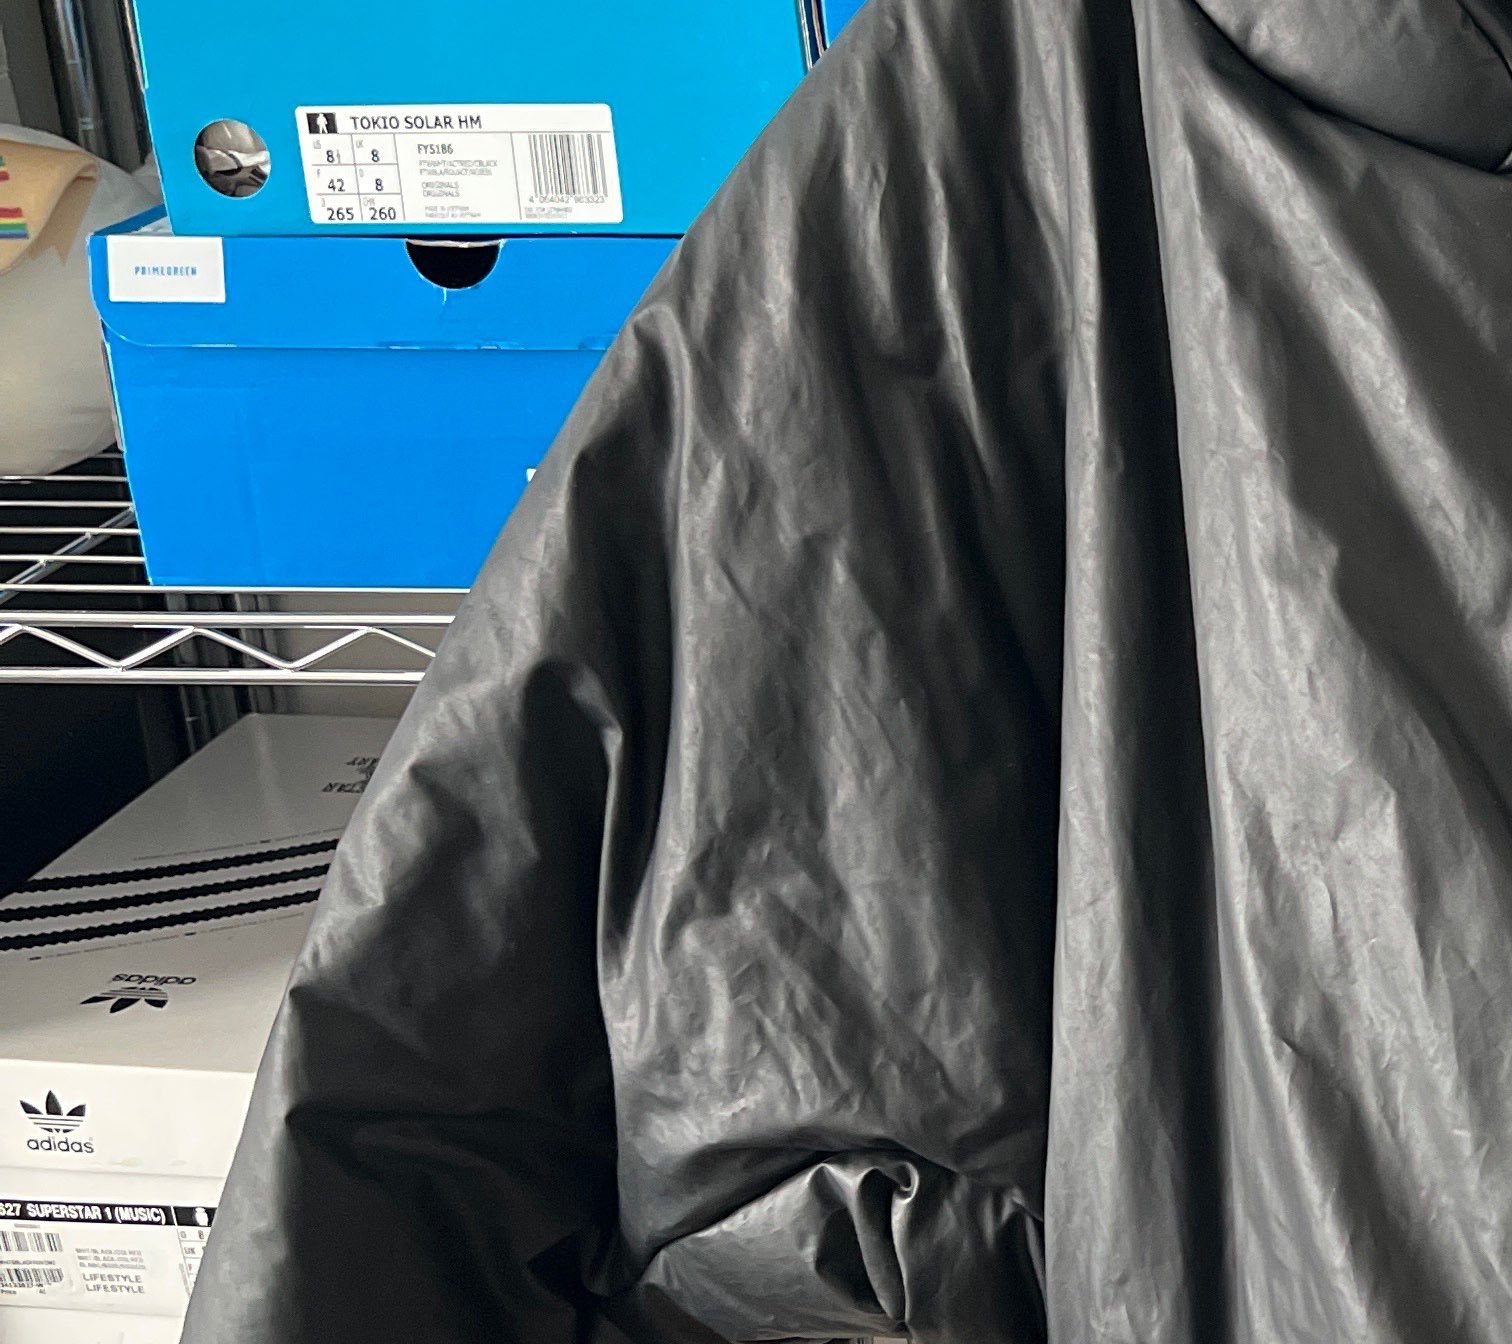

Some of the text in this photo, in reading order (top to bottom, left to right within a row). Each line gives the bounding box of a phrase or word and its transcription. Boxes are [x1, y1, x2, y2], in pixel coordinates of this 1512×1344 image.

[349, 116, 482, 131] TOKIO SOLAR HM
[371, 149, 380, 163] 8
[328, 178, 346, 192] 42
[375, 178, 384, 192] 8
[326, 207, 354, 221] 265
[370, 207, 397, 221] 260
[27, 1136, 94, 1153] adidas
[27, 1203, 101, 1221] SUPERSTAR
[105, 1208, 111, 1220] 1
[115, 1208, 166, 1225] (MUSIC)
[83, 1273, 142, 1284] LIFESTYLE
[86, 1284, 145, 1294] LIFESTYLE
